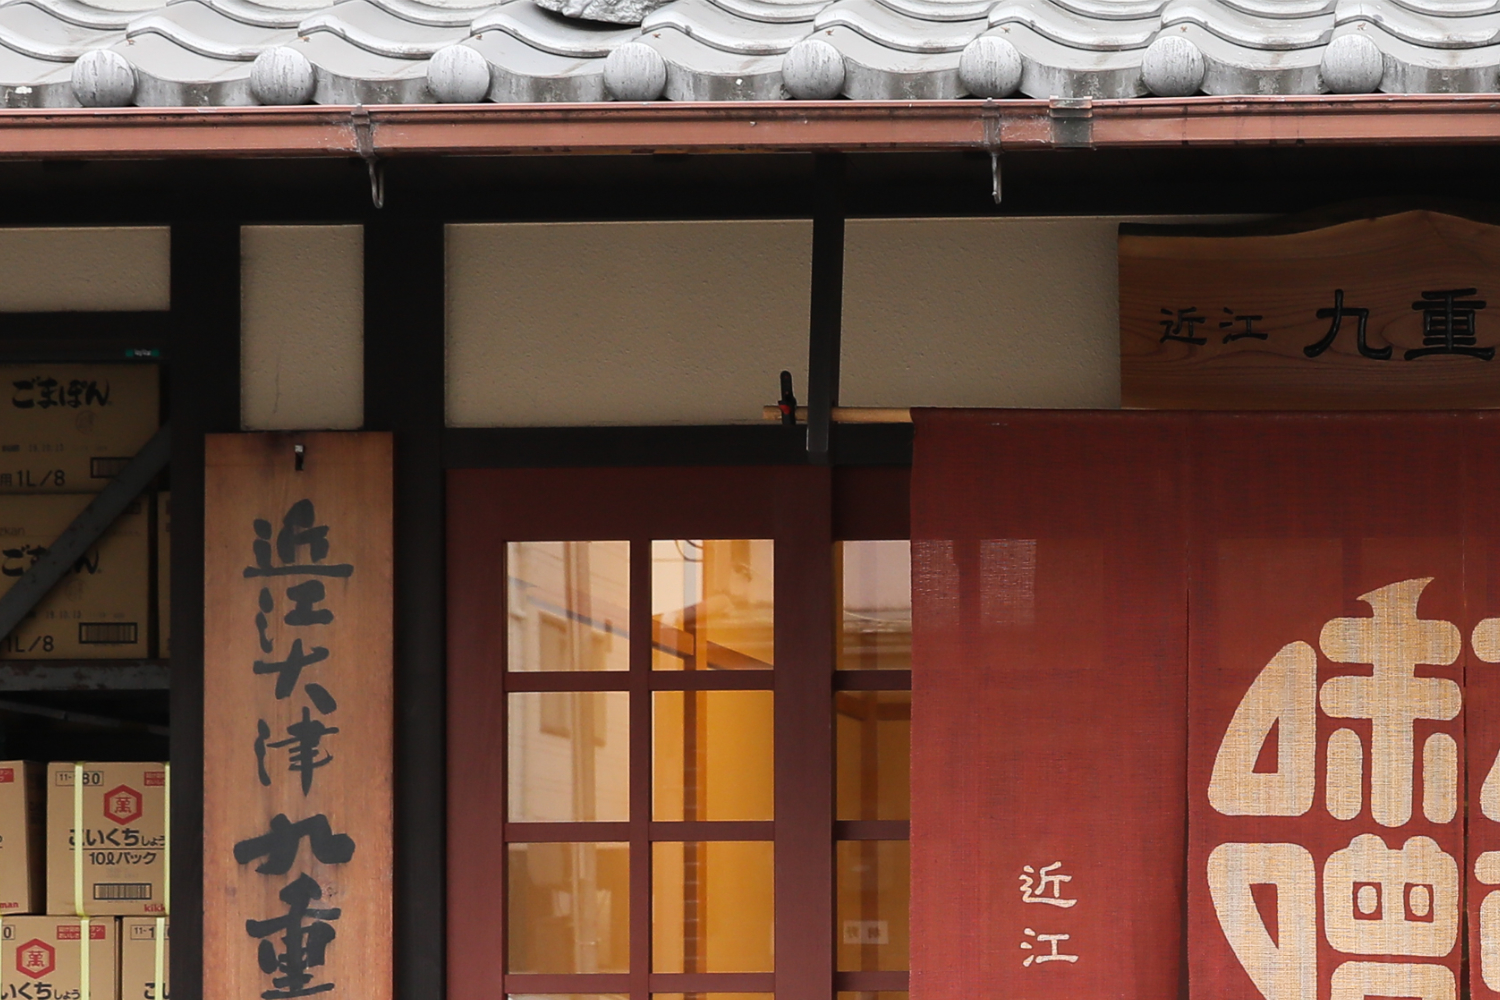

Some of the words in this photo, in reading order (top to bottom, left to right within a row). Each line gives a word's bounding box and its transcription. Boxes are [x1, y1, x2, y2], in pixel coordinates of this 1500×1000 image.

[1159, 307, 1268, 346] 近江
[59, 772, 100, 785] 11-80
[1019, 861, 1078, 967] 近江
